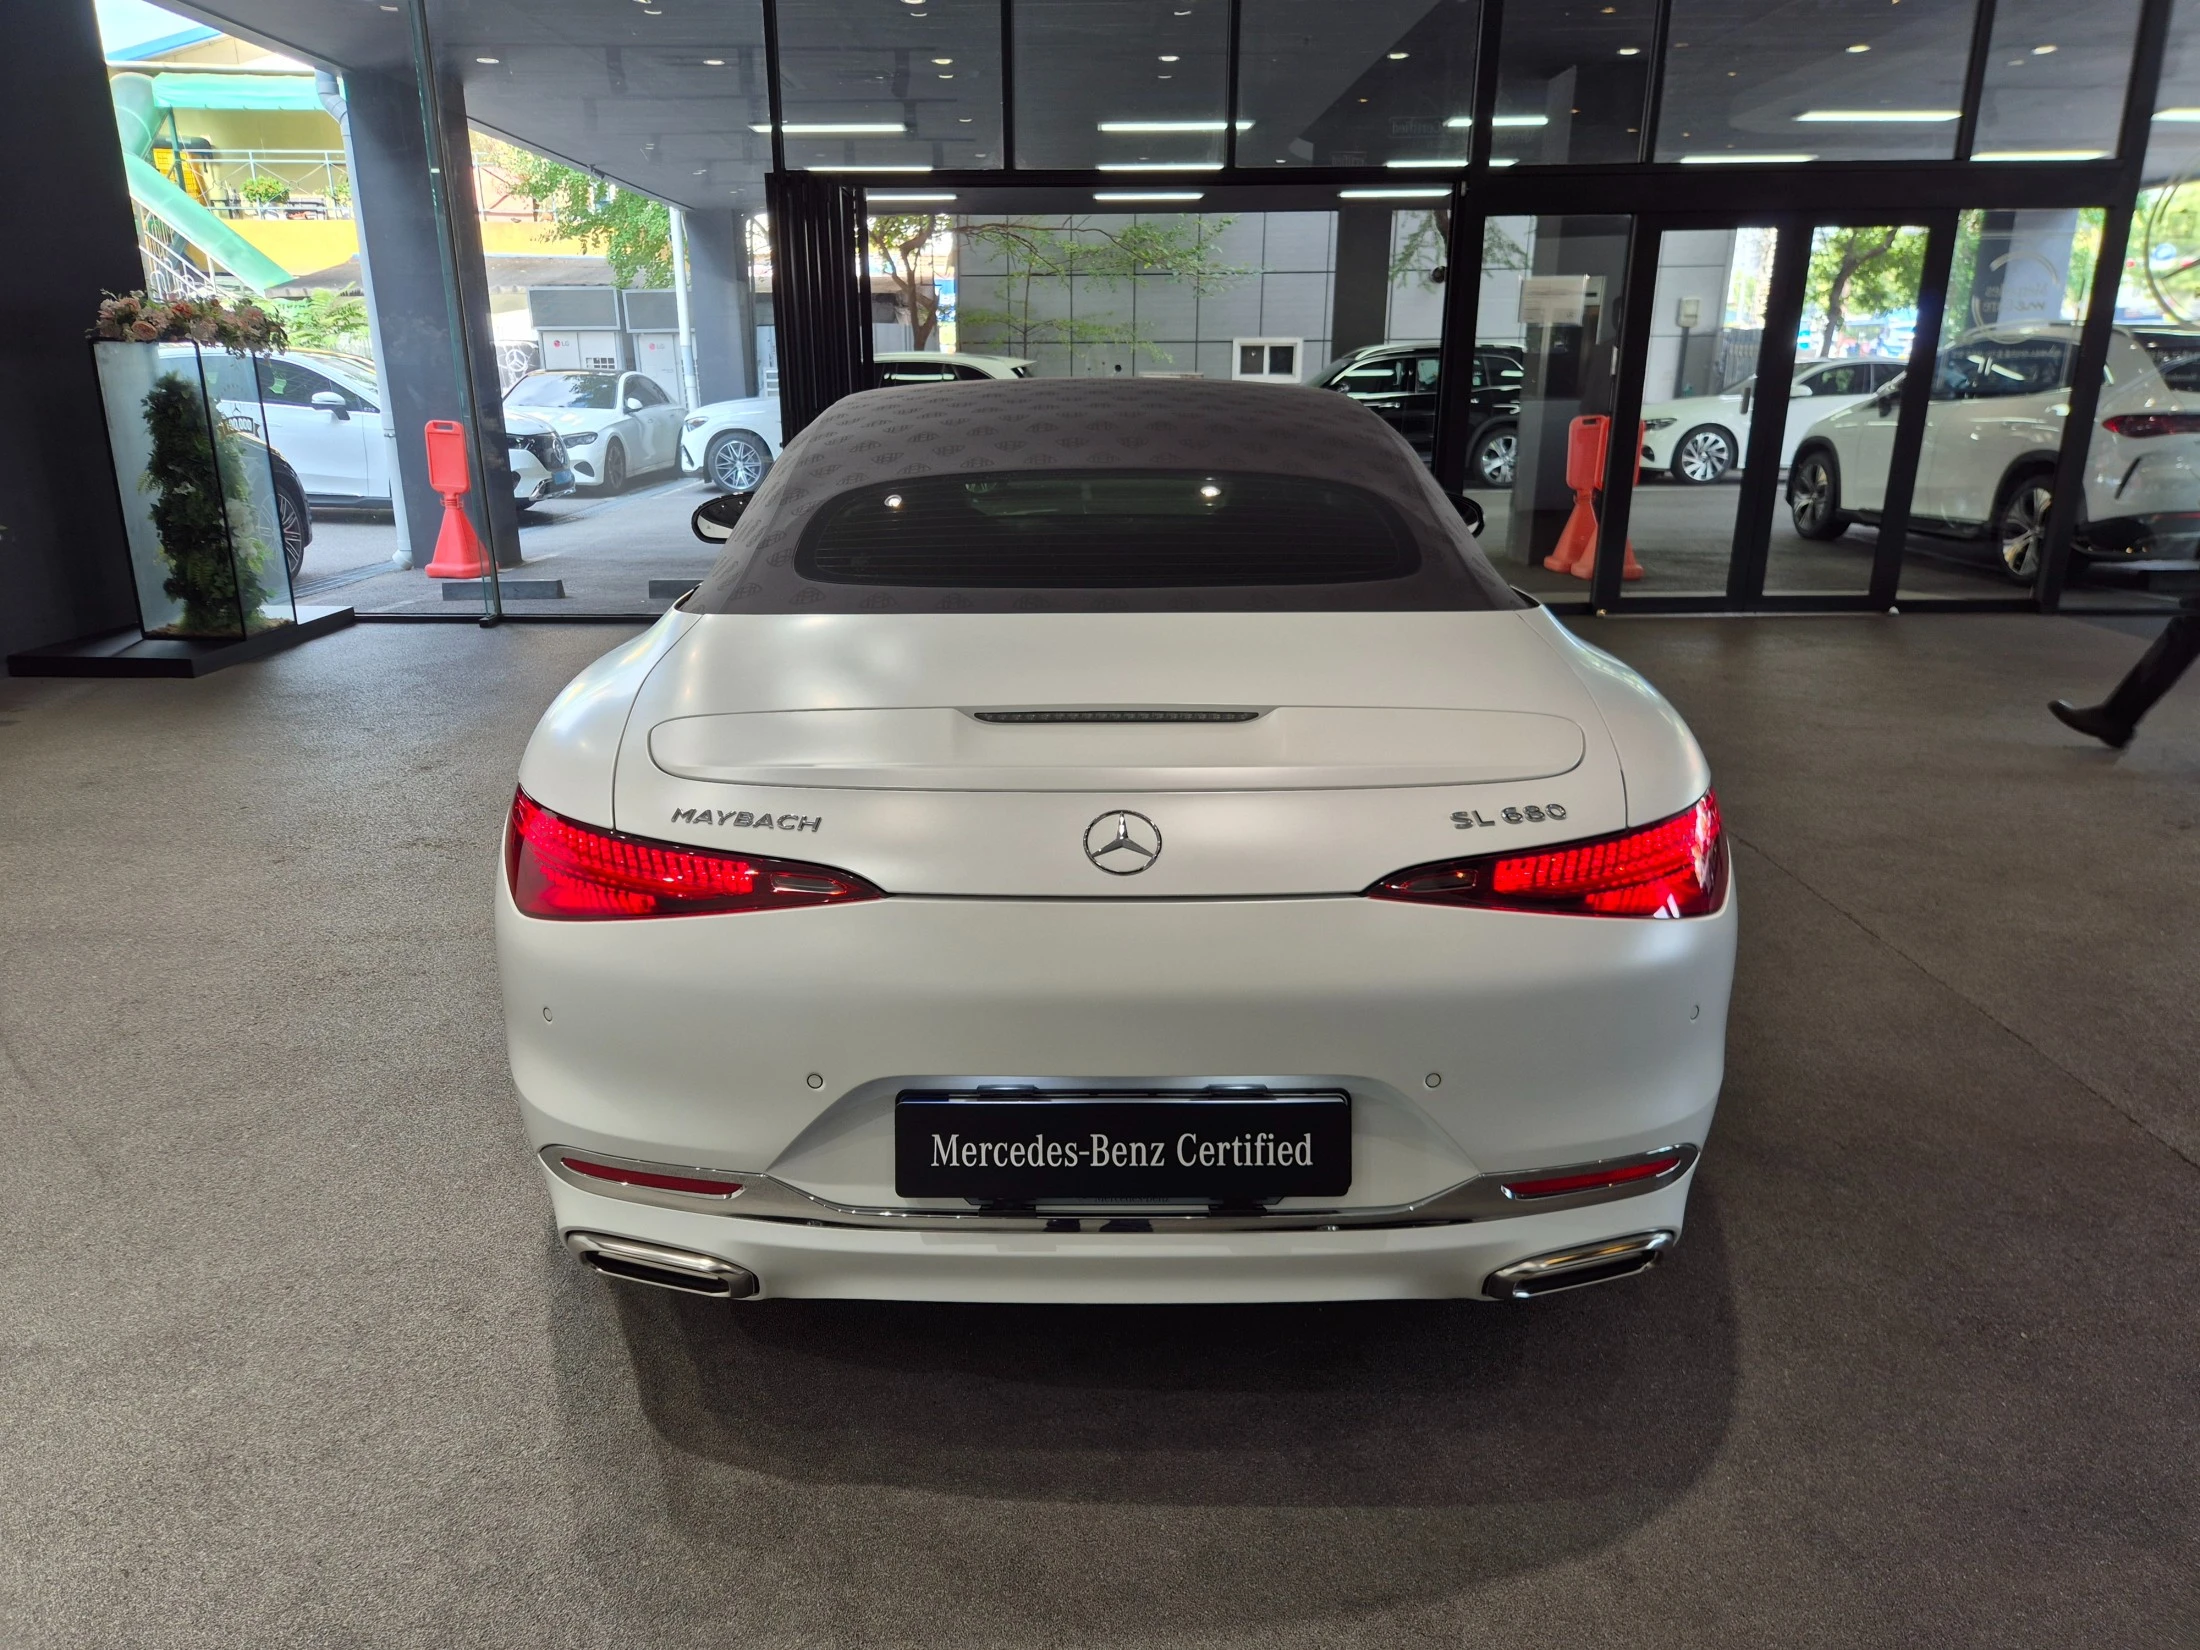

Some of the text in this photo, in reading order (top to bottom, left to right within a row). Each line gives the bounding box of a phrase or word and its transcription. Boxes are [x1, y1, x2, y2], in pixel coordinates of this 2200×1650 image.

[671, 807, 822, 832] MAYBACH
[1450, 803, 1567, 829] SL 680
[931, 1132, 1313, 1168] Mercedes-Benz Certified
